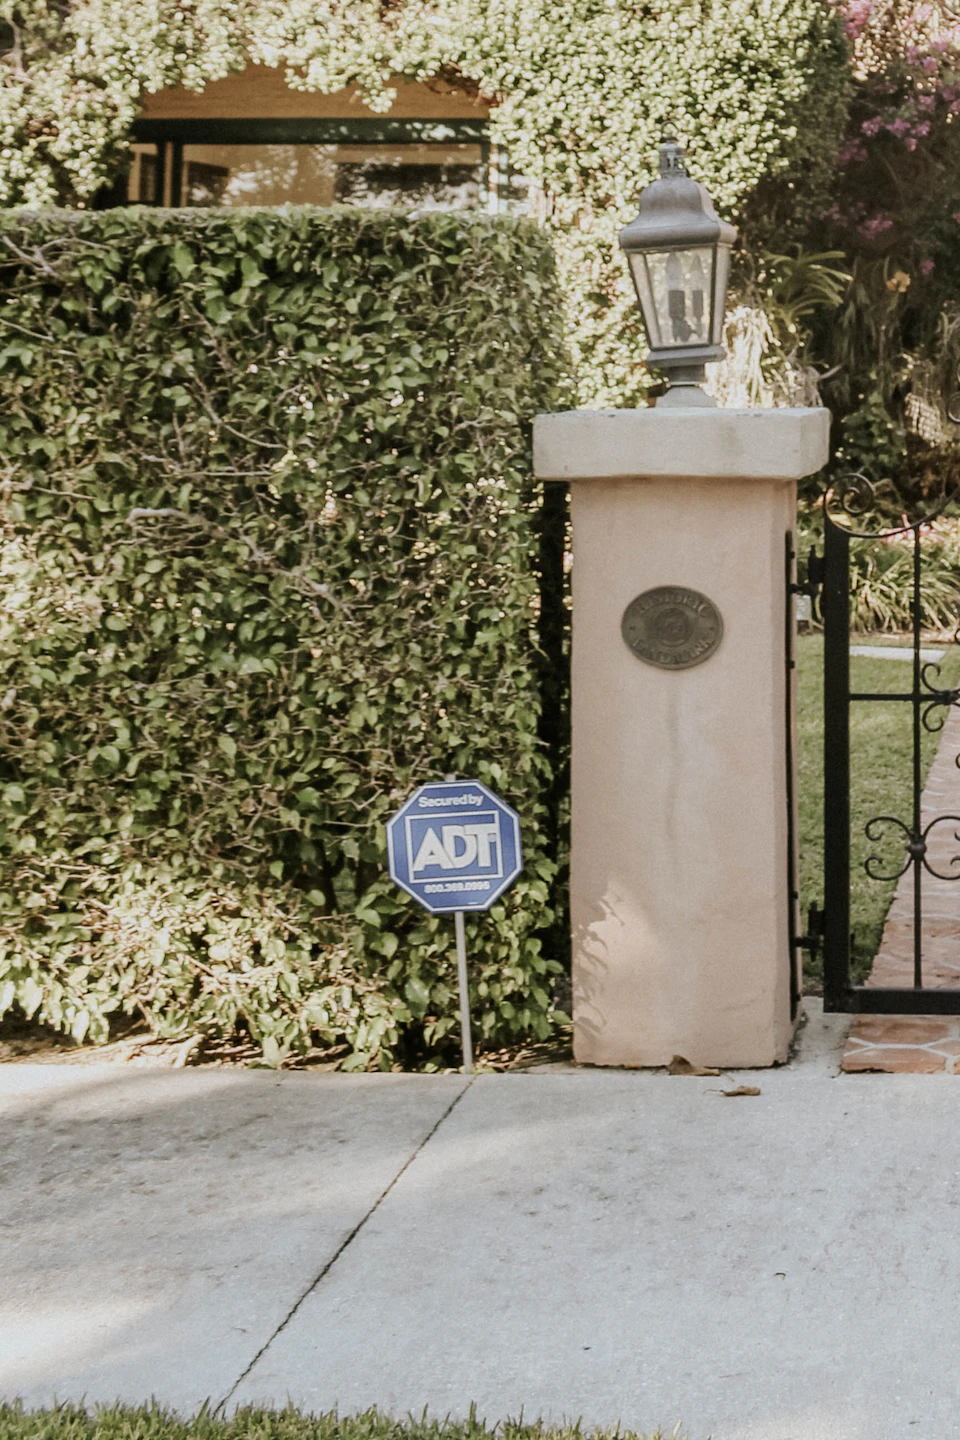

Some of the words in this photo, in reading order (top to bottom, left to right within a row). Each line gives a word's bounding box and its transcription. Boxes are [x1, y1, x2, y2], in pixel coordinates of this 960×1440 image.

[418, 793, 468, 808] Secured
[467, 793, 484, 807] by
[412, 823, 497, 872] ADT
